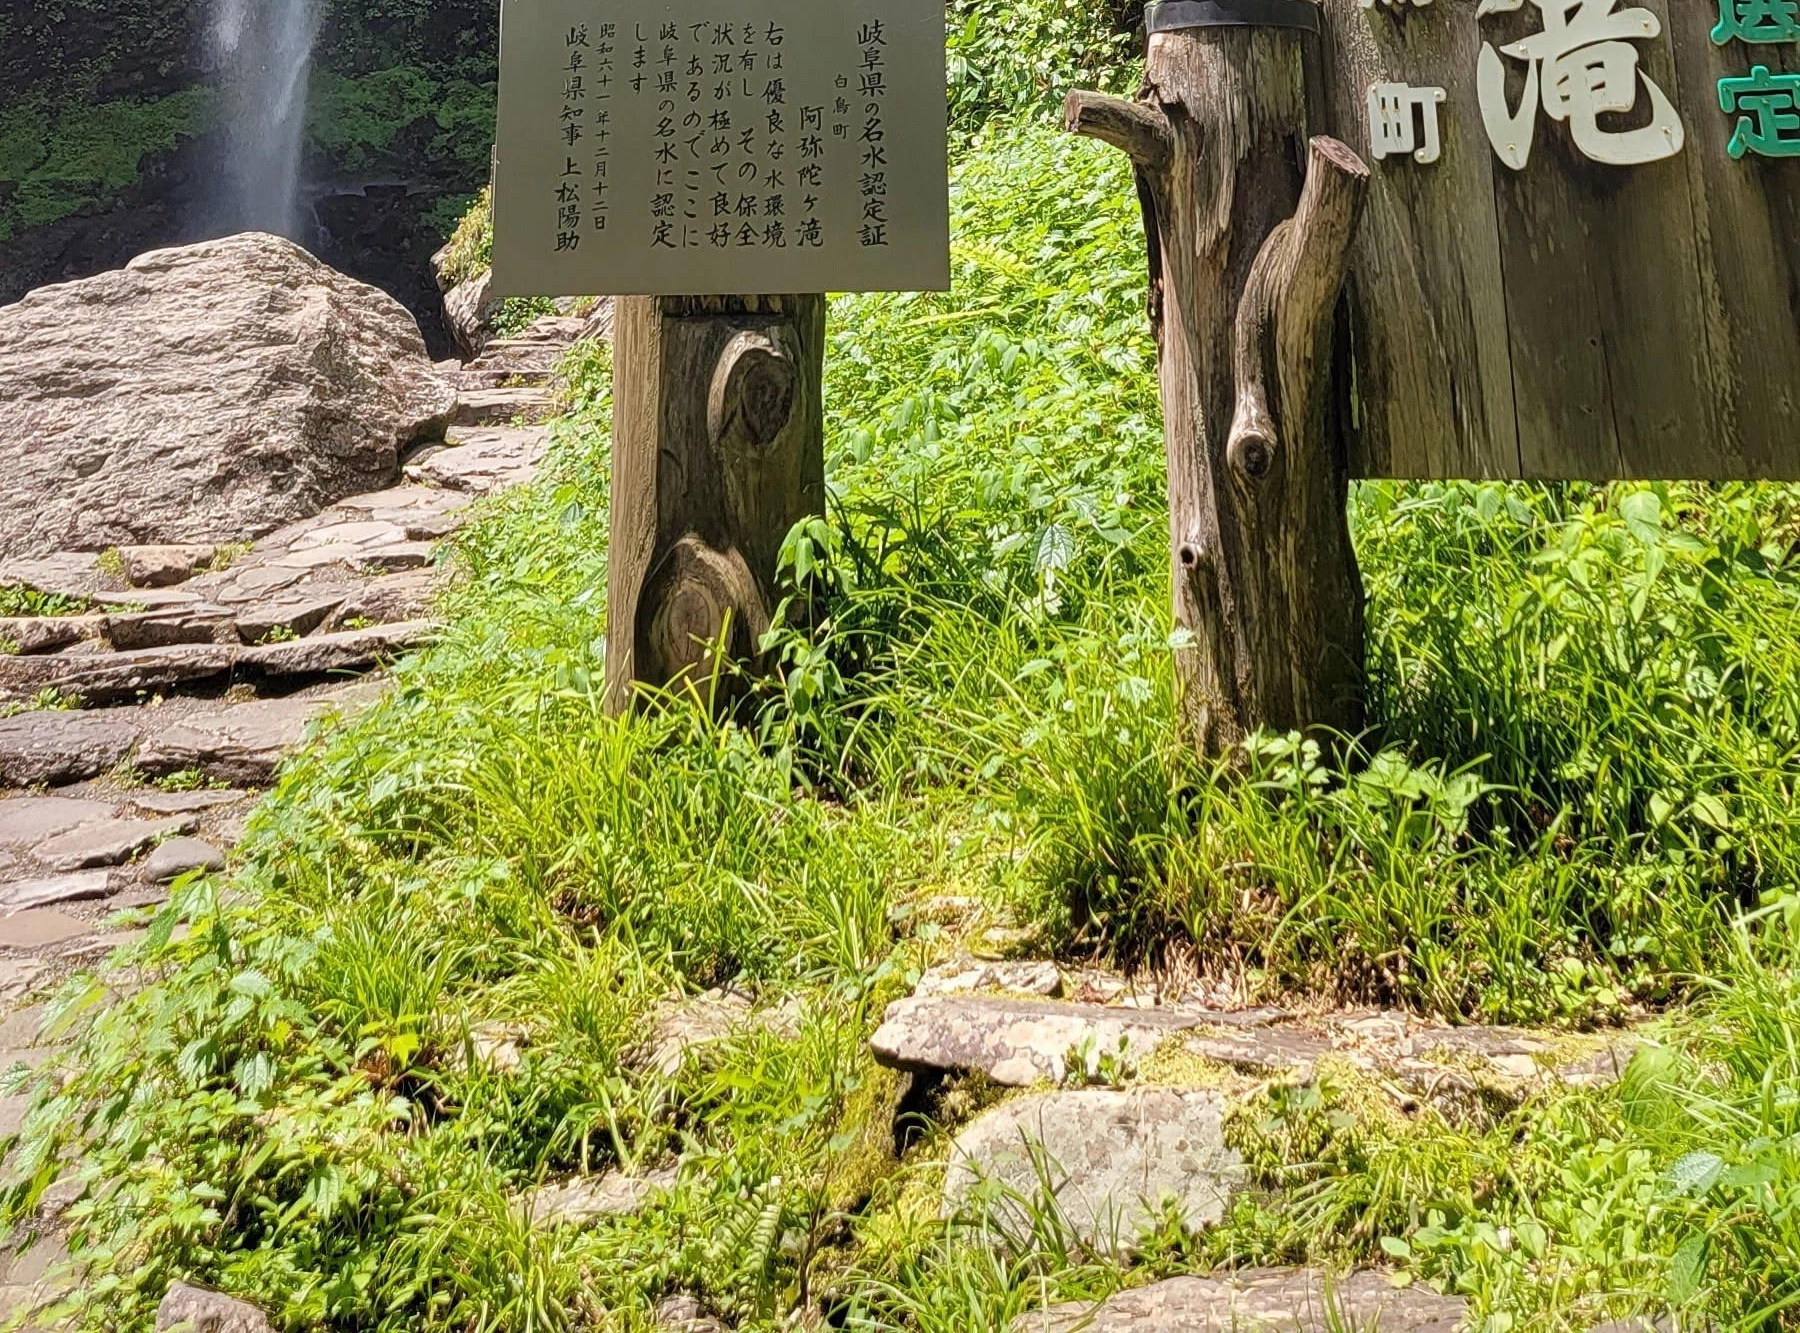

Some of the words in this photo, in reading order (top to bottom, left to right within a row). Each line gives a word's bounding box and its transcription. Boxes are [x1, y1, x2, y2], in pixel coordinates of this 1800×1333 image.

[592, 23, 616, 230] 昭和六十一年十二月十二日
[629, 22, 648, 96] します
[650, 21, 680, 249] 岐阜県の名水に認定
[682, 21, 710, 248] であるのでここに
[705, 22, 735, 248] 状況が極めて良好
[760, 21, 787, 248] 右は優良な水環境
[832, 74, 851, 139] 白鳥町
[856, 19, 889, 247] 岐阜県の名水認定証
